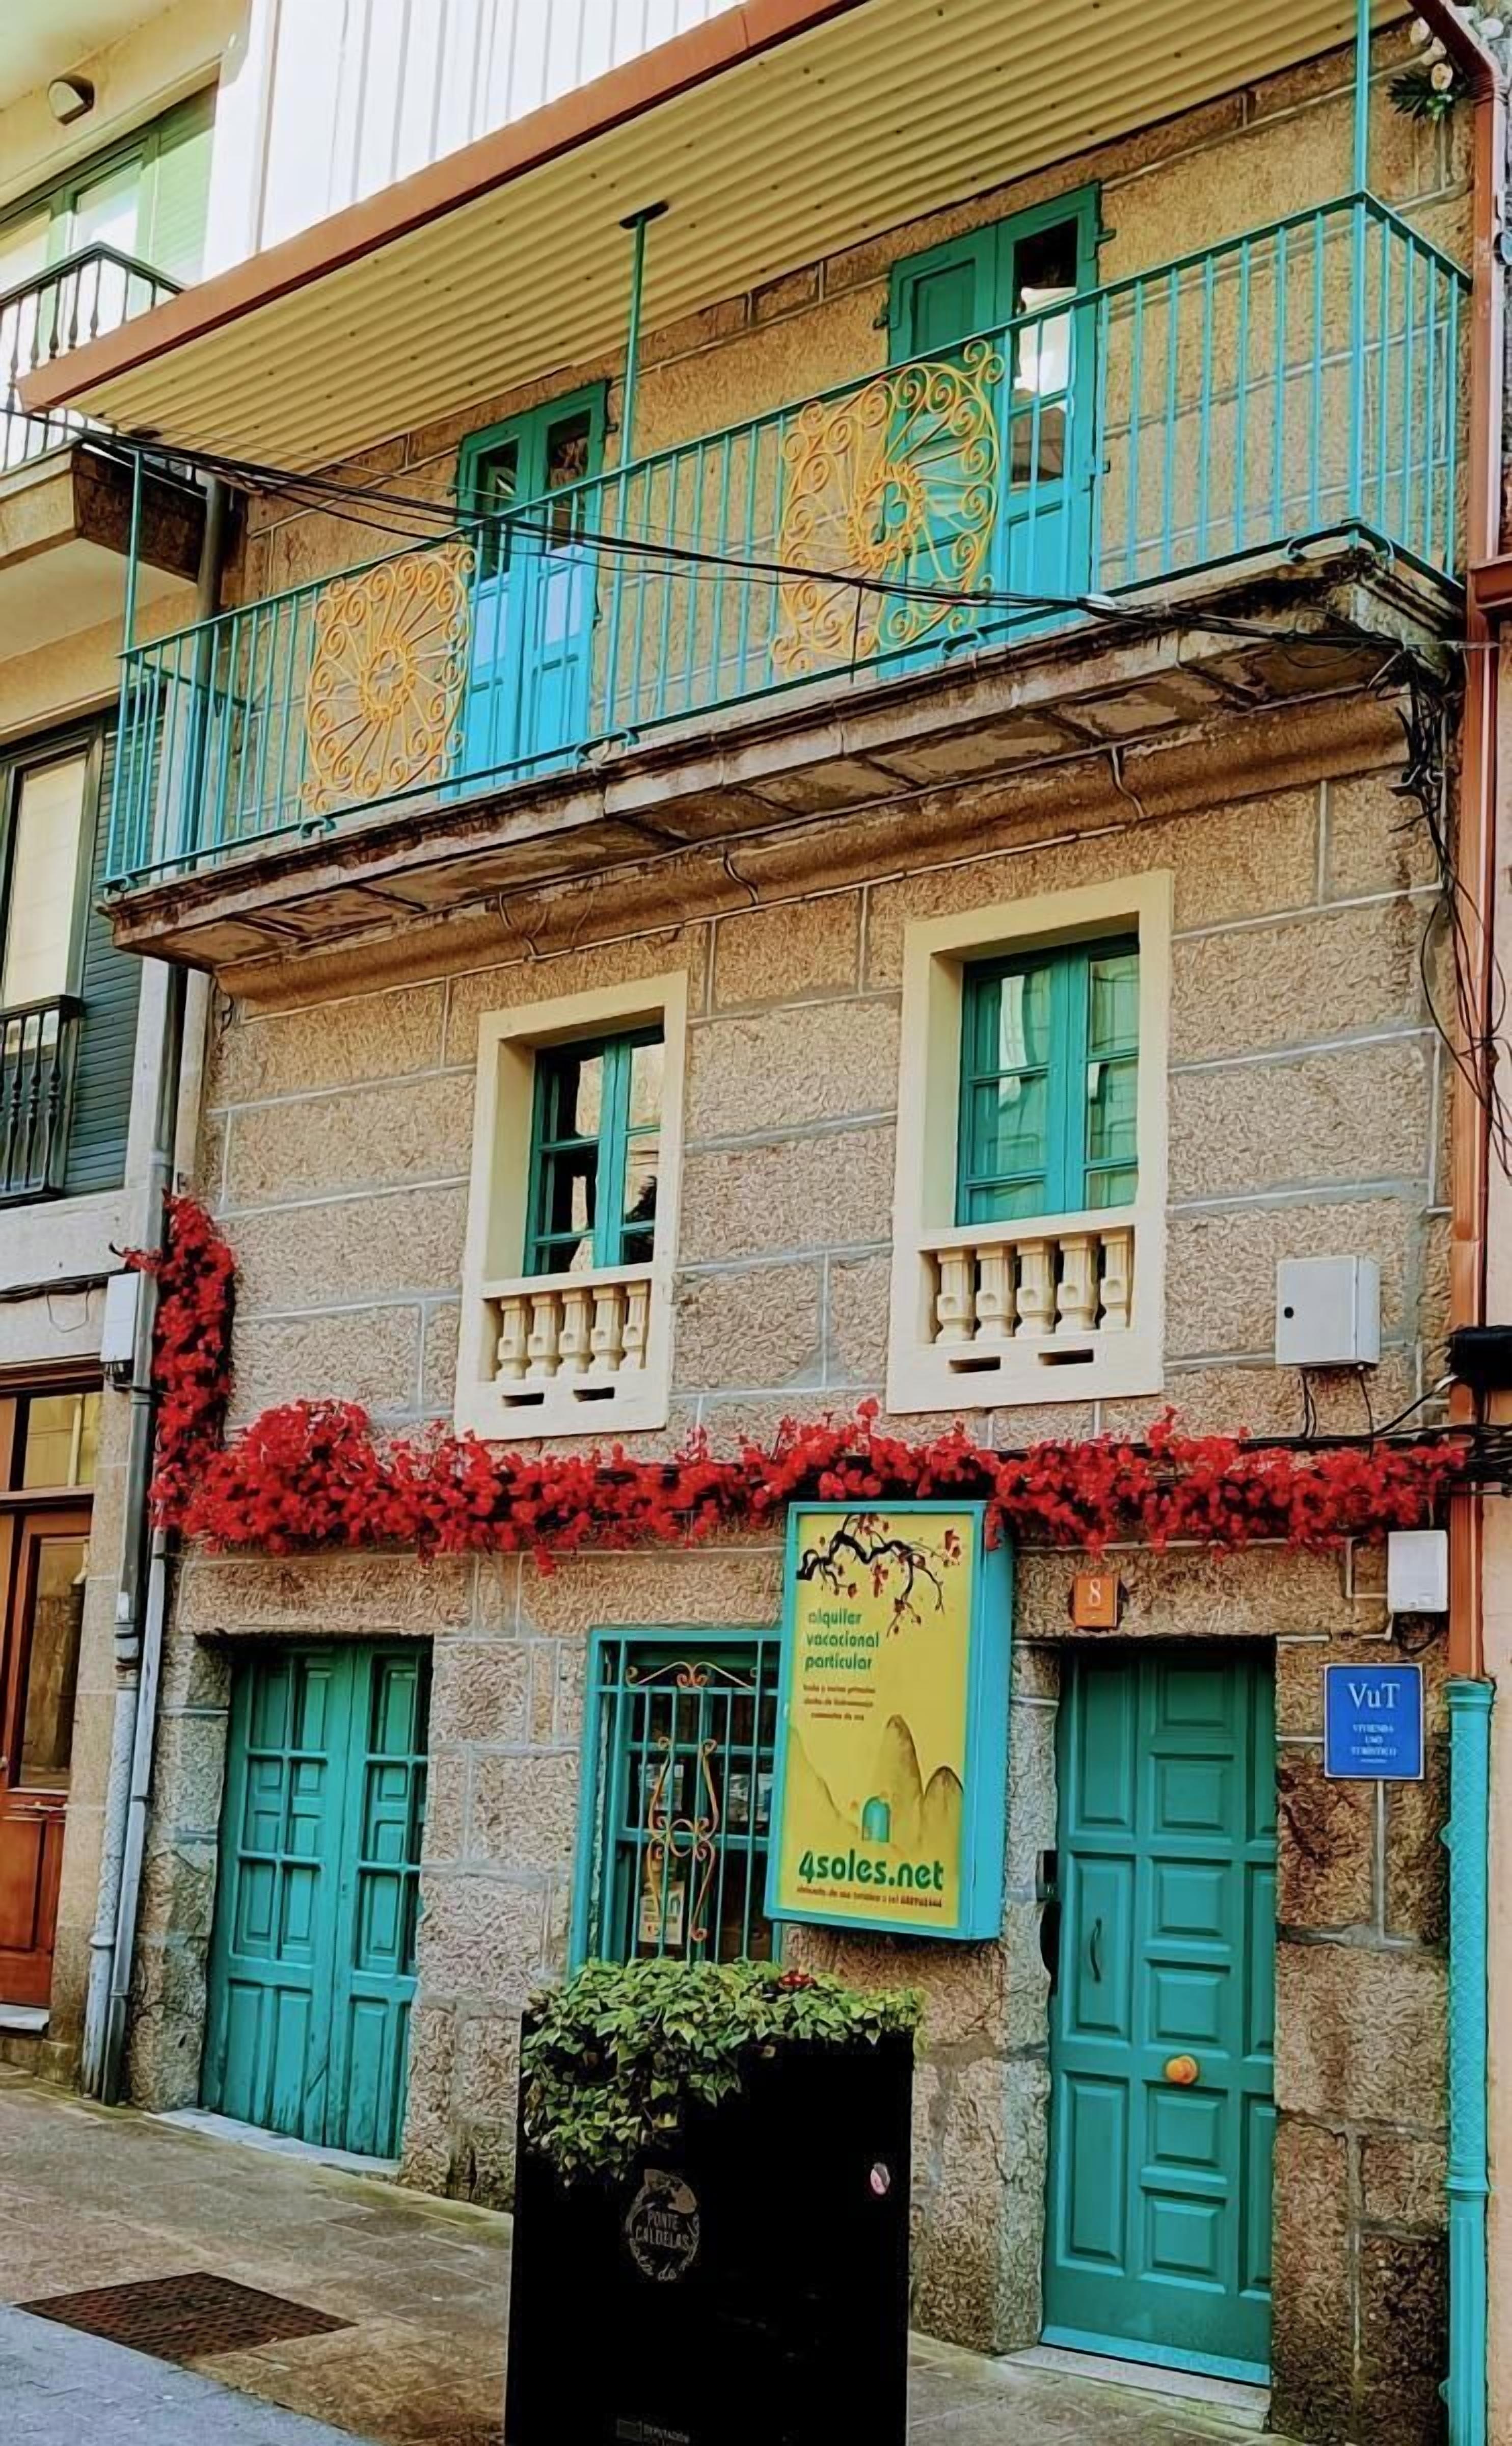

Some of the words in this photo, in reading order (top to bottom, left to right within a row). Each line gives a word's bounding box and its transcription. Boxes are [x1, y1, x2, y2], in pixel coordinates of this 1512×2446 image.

[1090, 1578, 1101, 1607] 8
[808, 1608, 862, 1628] alquiler
[806, 1632, 879, 1648] vacacional
[805, 1653, 872, 1671] particular
[1348, 1683, 1401, 1709] VuT
[799, 1848, 944, 1892] 4soles.net
[647, 2209, 679, 2231] PONTE
